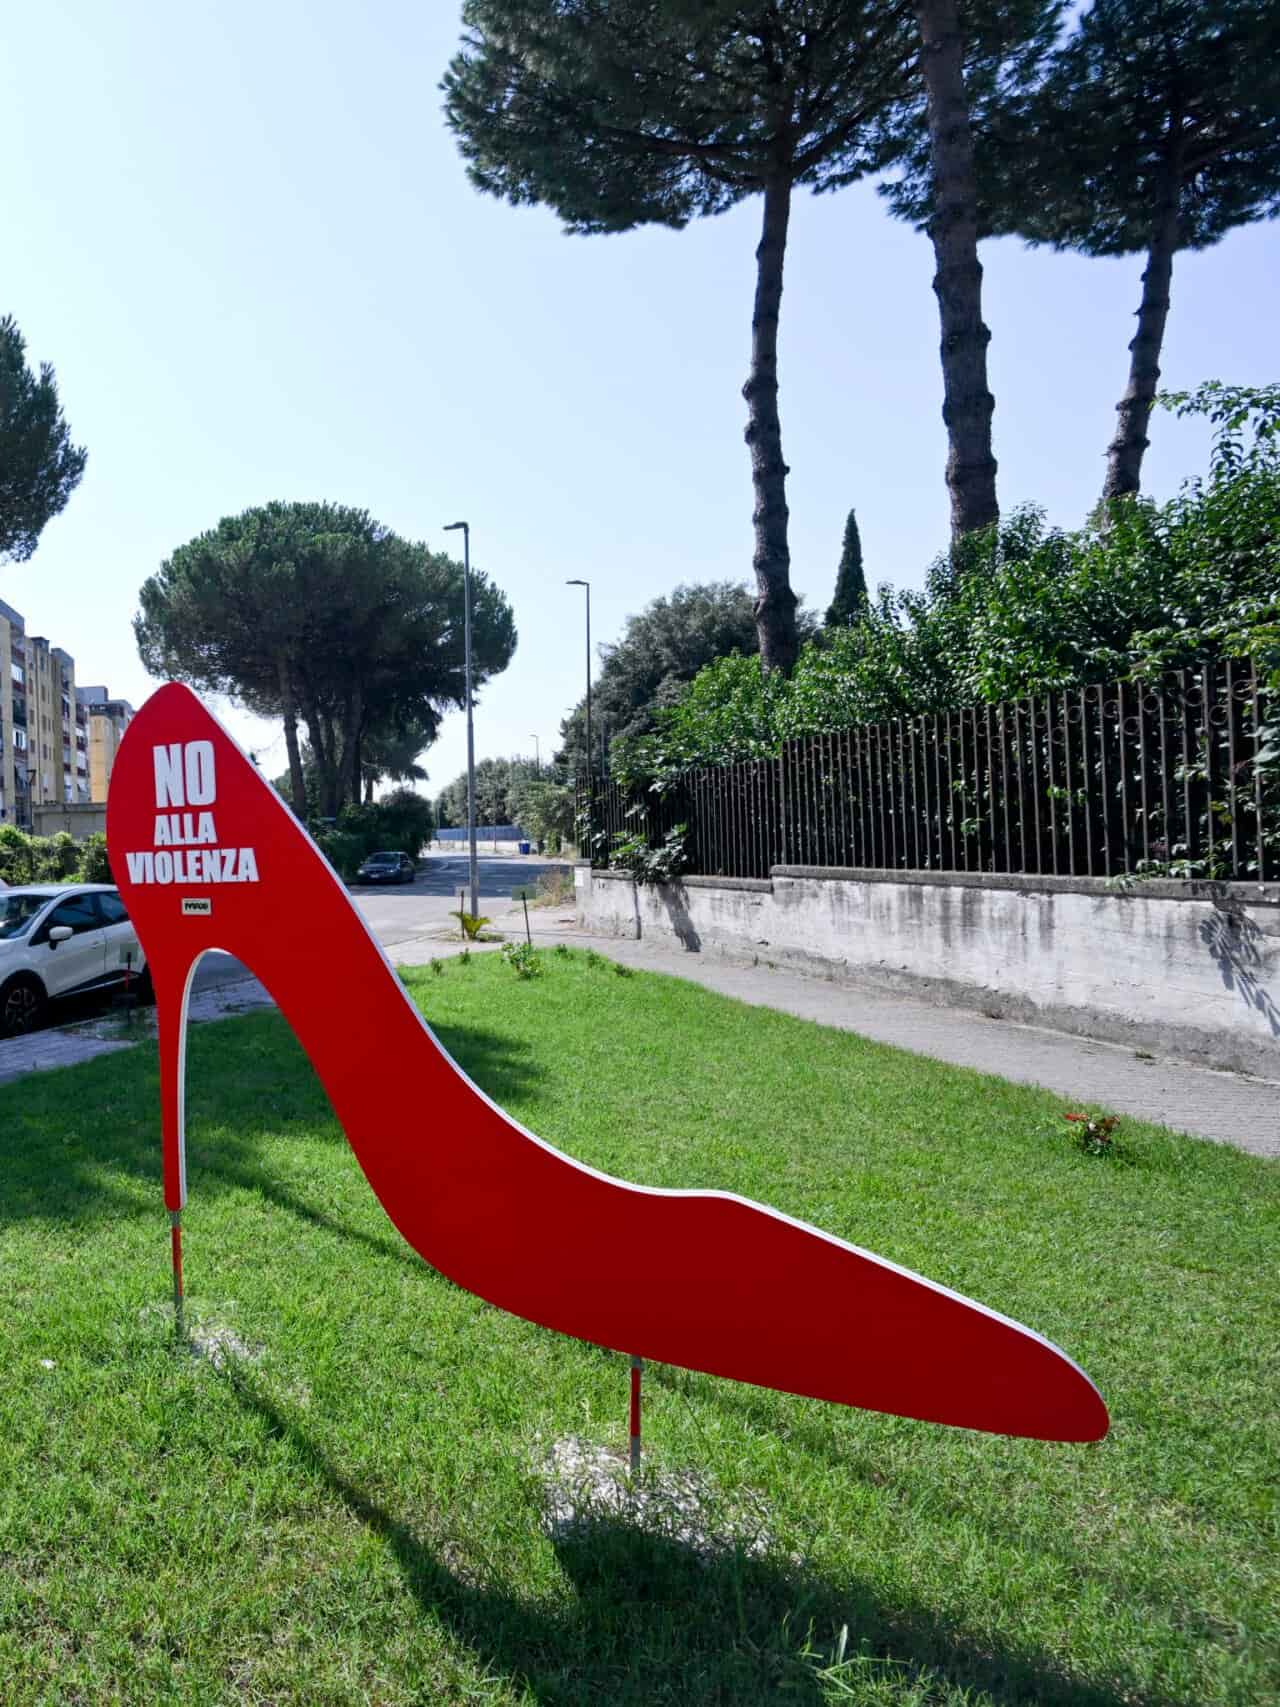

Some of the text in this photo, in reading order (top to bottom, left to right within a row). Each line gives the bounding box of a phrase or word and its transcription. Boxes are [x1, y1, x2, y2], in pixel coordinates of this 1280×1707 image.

[153, 740, 216, 808] NO
[153, 811, 218, 846] ALLA
[125, 847, 260, 885] VIOLENZA
